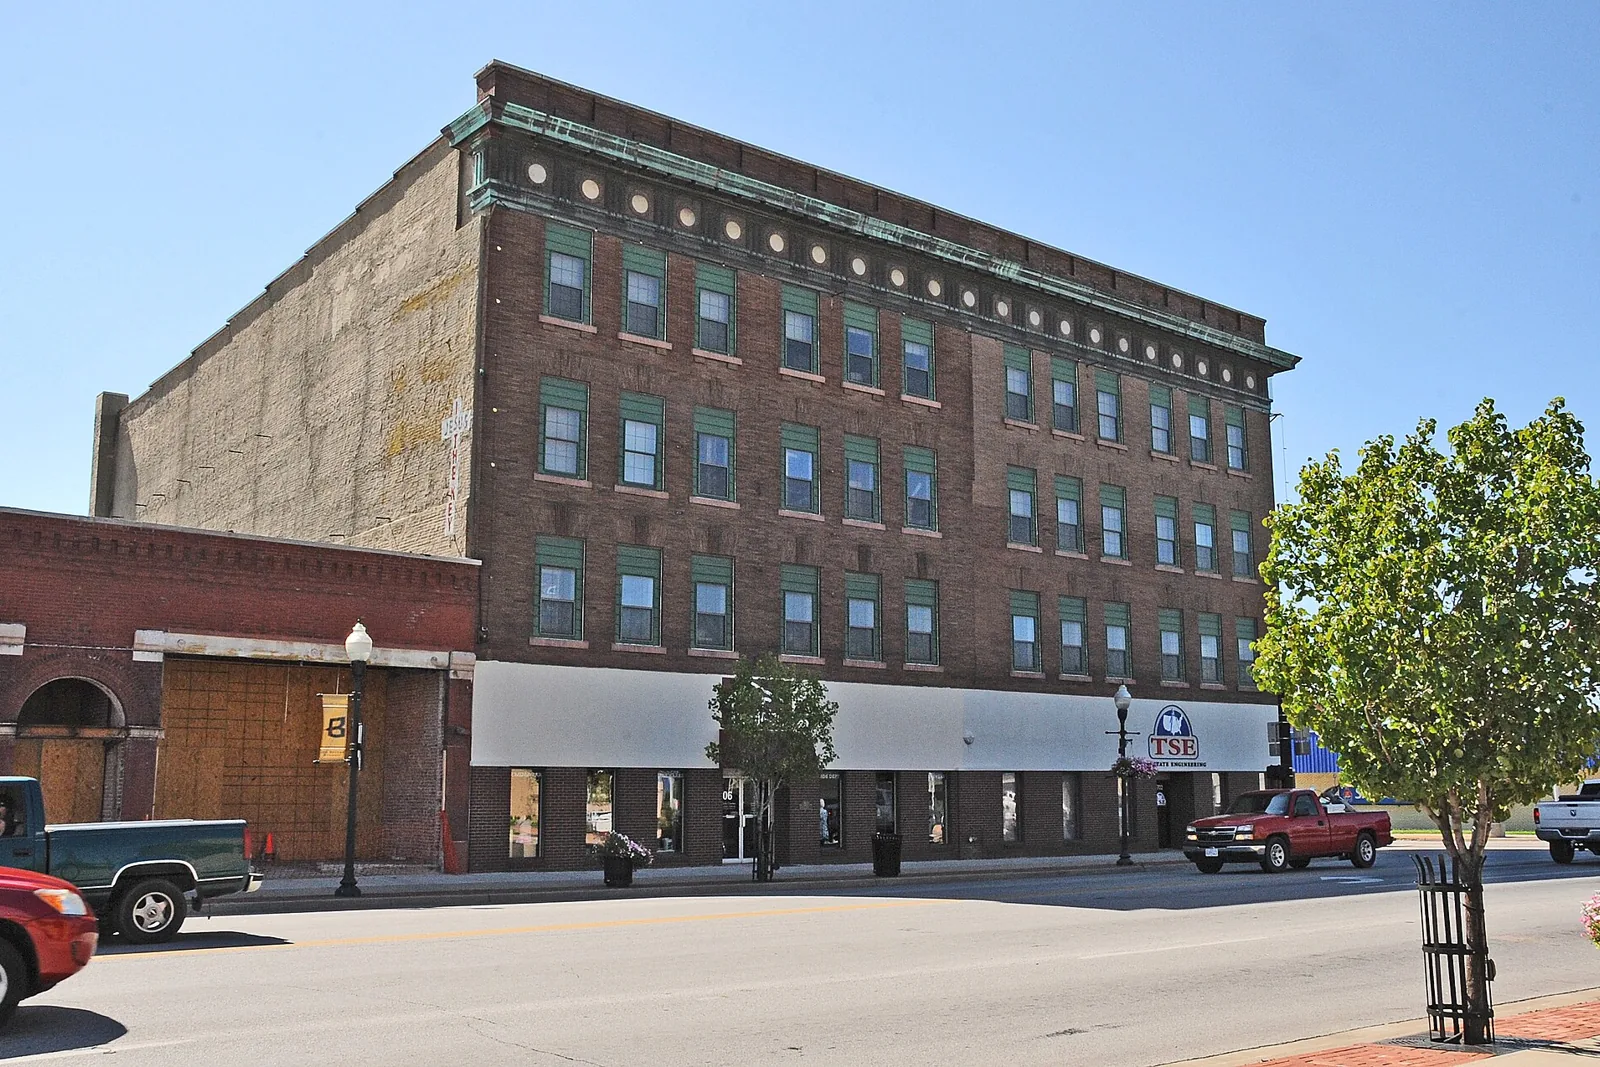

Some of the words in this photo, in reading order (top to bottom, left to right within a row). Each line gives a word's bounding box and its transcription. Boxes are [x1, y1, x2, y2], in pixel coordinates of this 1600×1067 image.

[444, 414, 469, 436] JESUS
[325, 716, 346, 738] B
[1150, 737, 1197, 756] TSE
